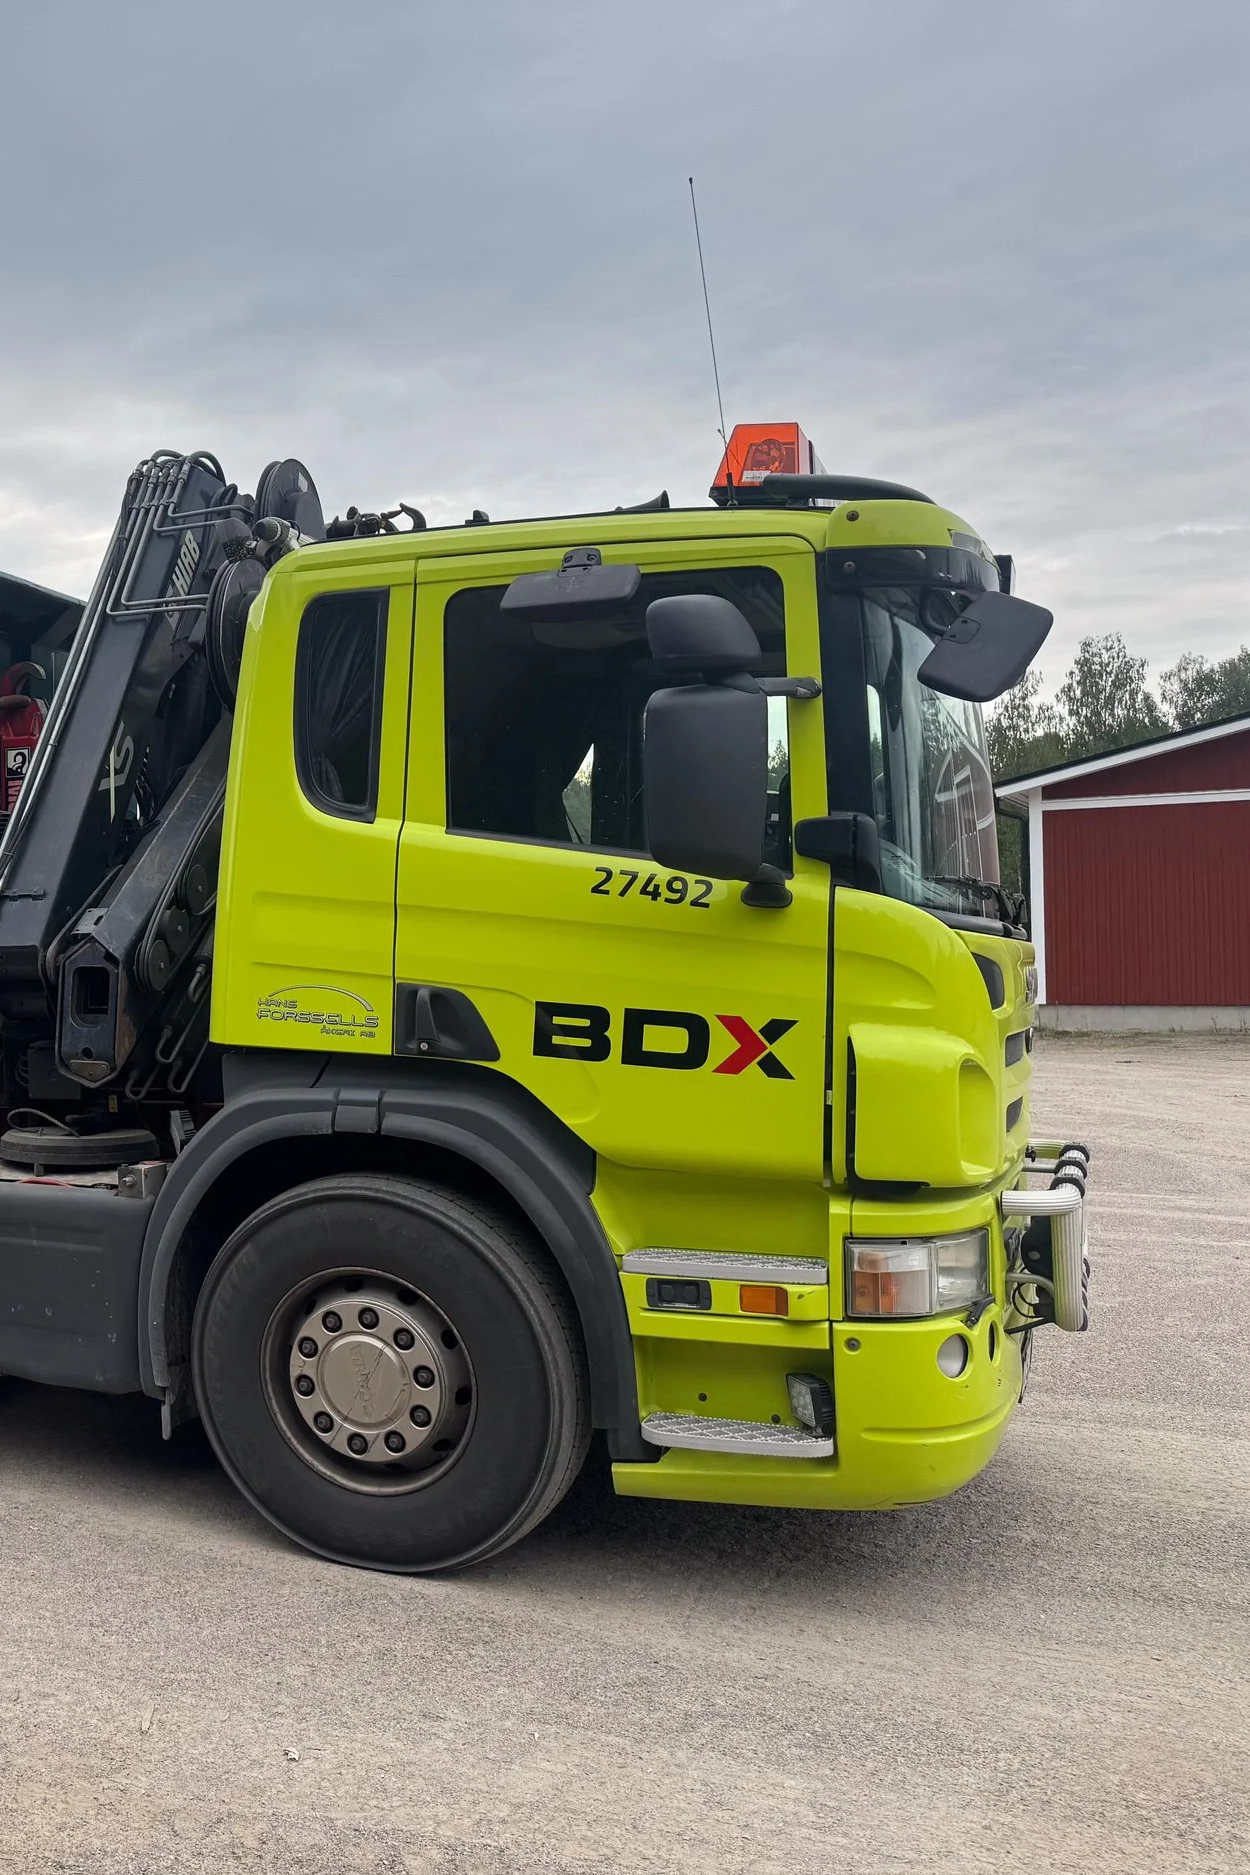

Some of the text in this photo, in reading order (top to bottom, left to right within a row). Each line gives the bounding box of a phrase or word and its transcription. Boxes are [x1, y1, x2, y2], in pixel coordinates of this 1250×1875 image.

[171, 529, 201, 598] HIAB
[590, 866, 713, 909] 27492
[256, 1008, 379, 1028] FORSSELLS
[257, 998, 298, 1009] HANS
[532, 1000, 799, 1081] BDX
